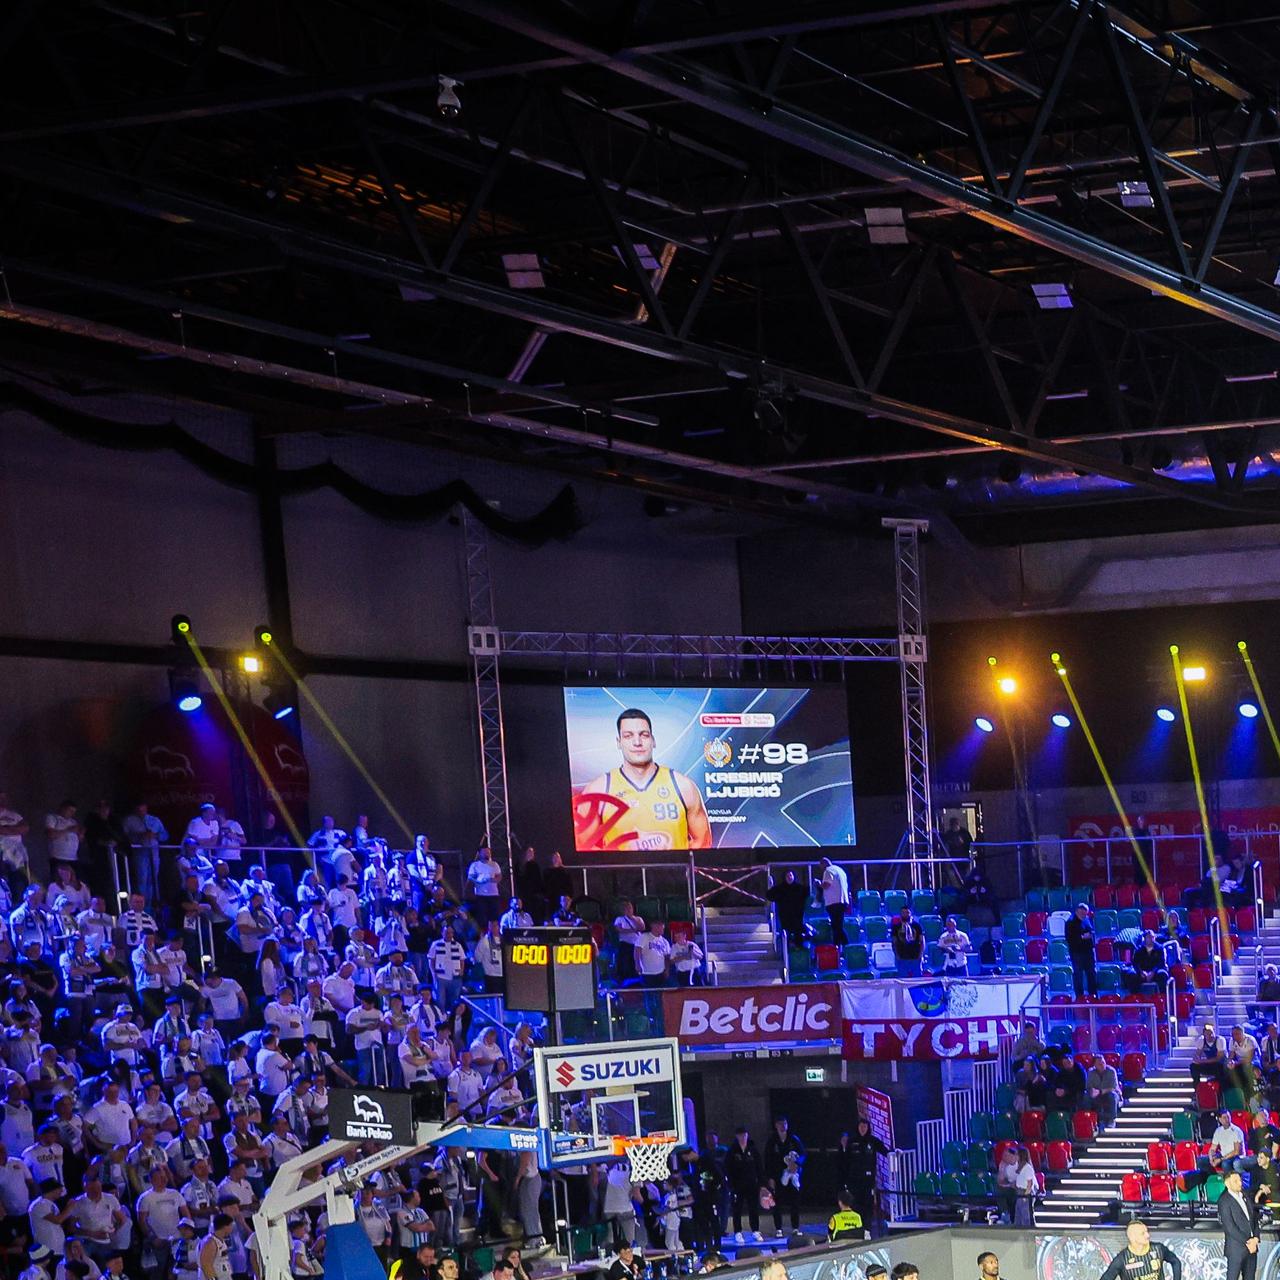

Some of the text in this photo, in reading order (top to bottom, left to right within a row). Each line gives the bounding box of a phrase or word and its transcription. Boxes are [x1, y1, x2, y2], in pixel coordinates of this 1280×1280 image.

[738, 743, 808, 764] #98
[512, 945, 548, 965] 10:00
[556, 944, 592, 964] 10:00
[680, 993, 832, 1036] Betclic
[581, 1057, 660, 1082] SUZUKI
[346, 1126, 393, 1141] Bank Pekao
